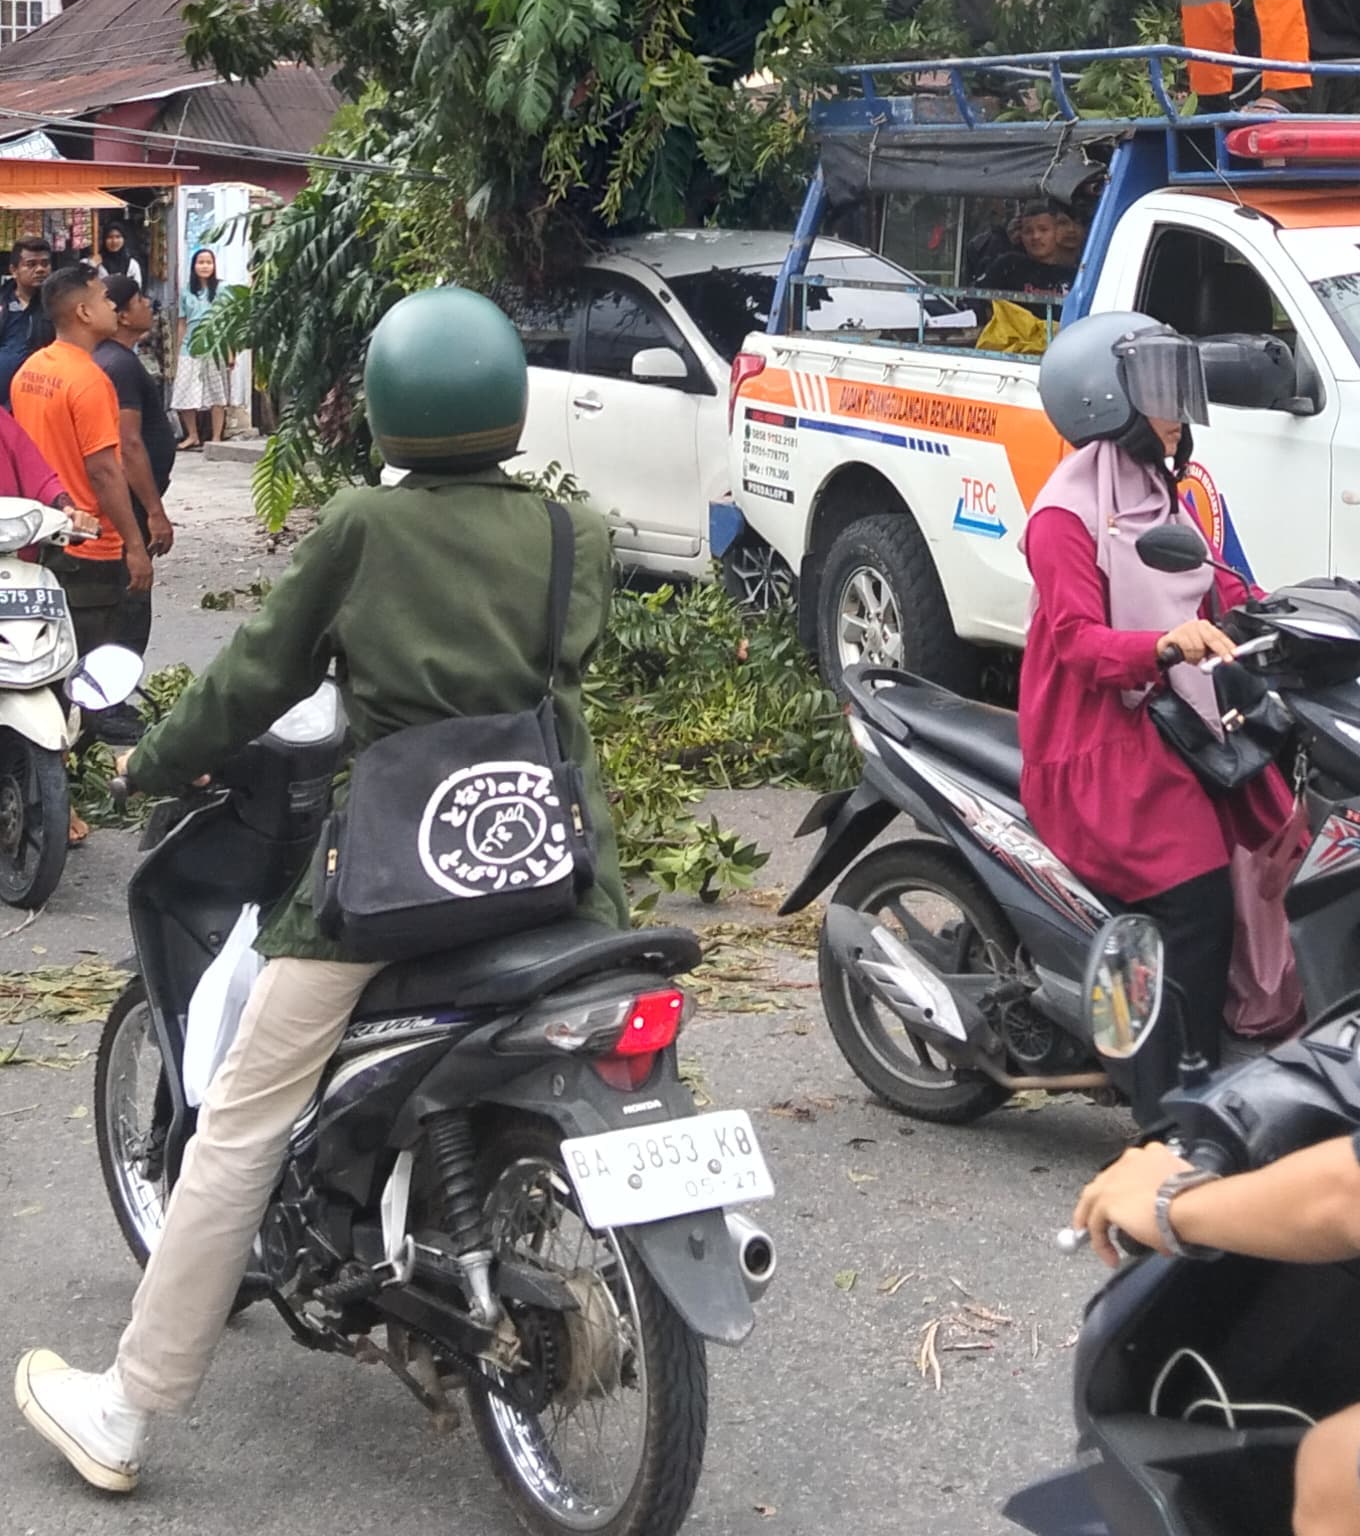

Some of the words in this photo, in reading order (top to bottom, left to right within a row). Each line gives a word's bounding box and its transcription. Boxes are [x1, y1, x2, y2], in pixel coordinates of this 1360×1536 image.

[961, 477, 996, 515] TRC
[623, 1099, 662, 1114] HONDA
[572, 1148, 611, 1179] BA
[627, 1133, 699, 1172] 3853
